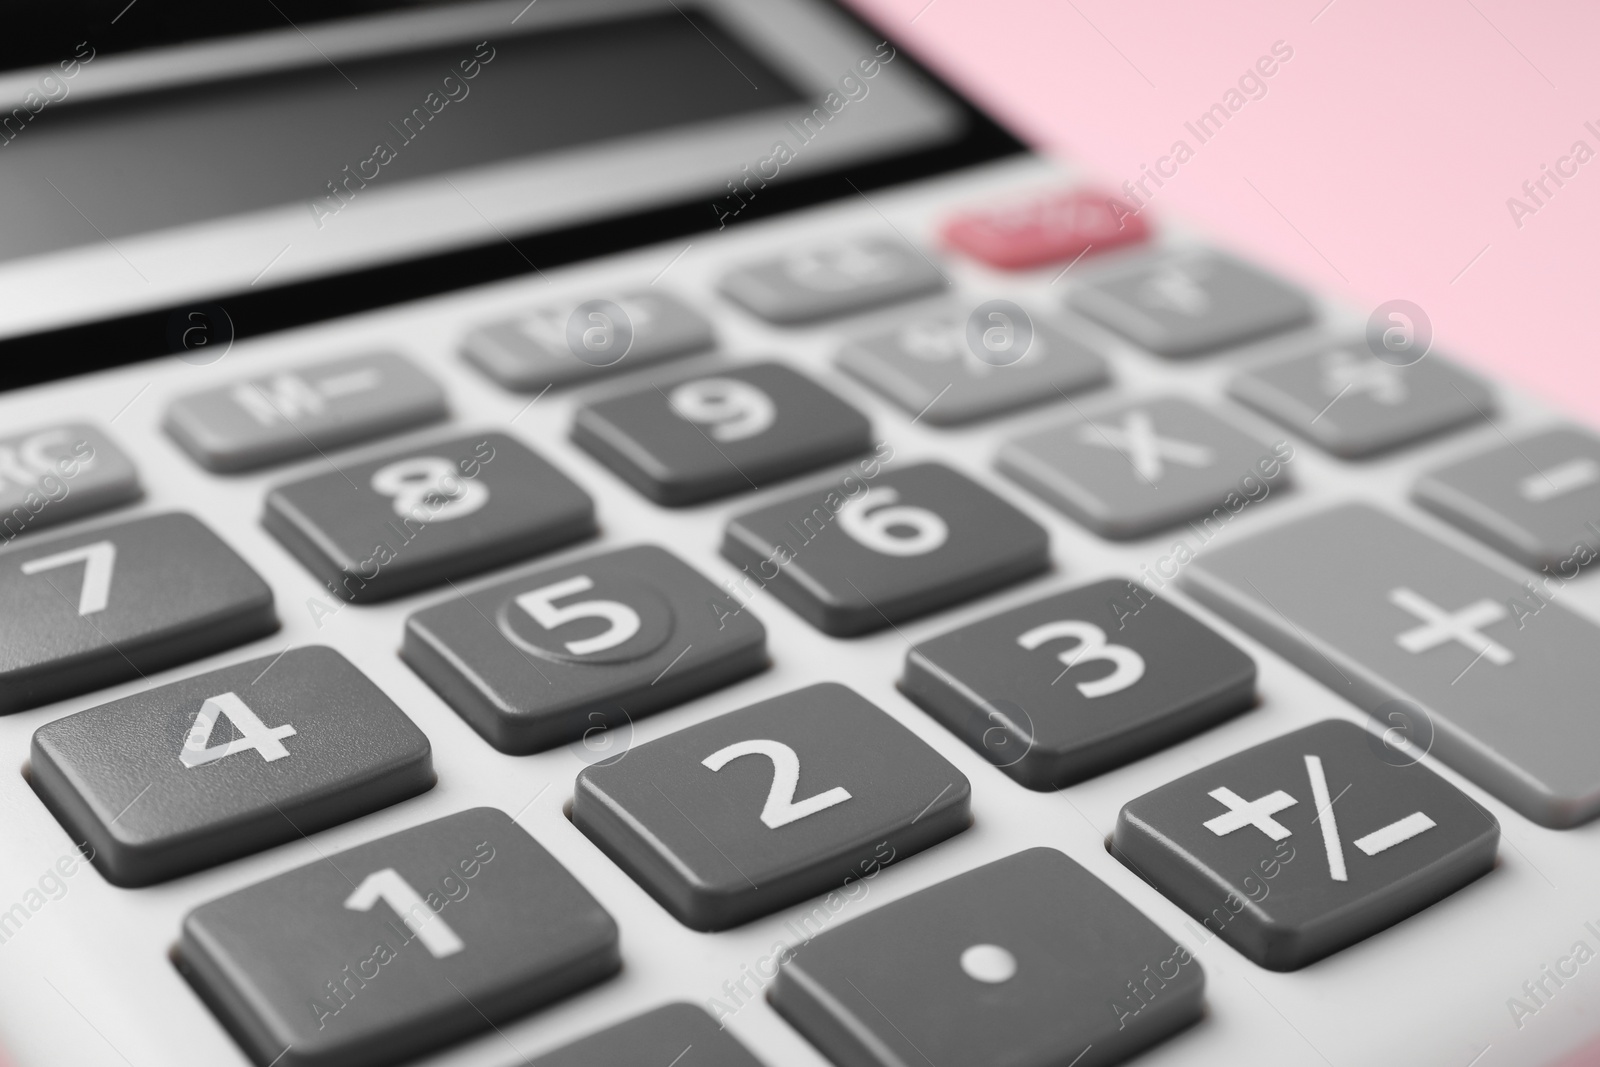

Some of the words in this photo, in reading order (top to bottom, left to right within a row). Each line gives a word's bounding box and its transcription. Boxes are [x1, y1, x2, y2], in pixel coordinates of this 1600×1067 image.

[669, 378, 775, 441] 9
[371, 456, 489, 523] 8
[837, 486, 949, 557] 6
[21, 541, 116, 617] 7
[515, 575, 641, 656] 5
[1017, 620, 1146, 699] 3
[178, 691, 298, 769] 4
[700, 739, 852, 829] 2
[344, 868, 463, 957] 1
